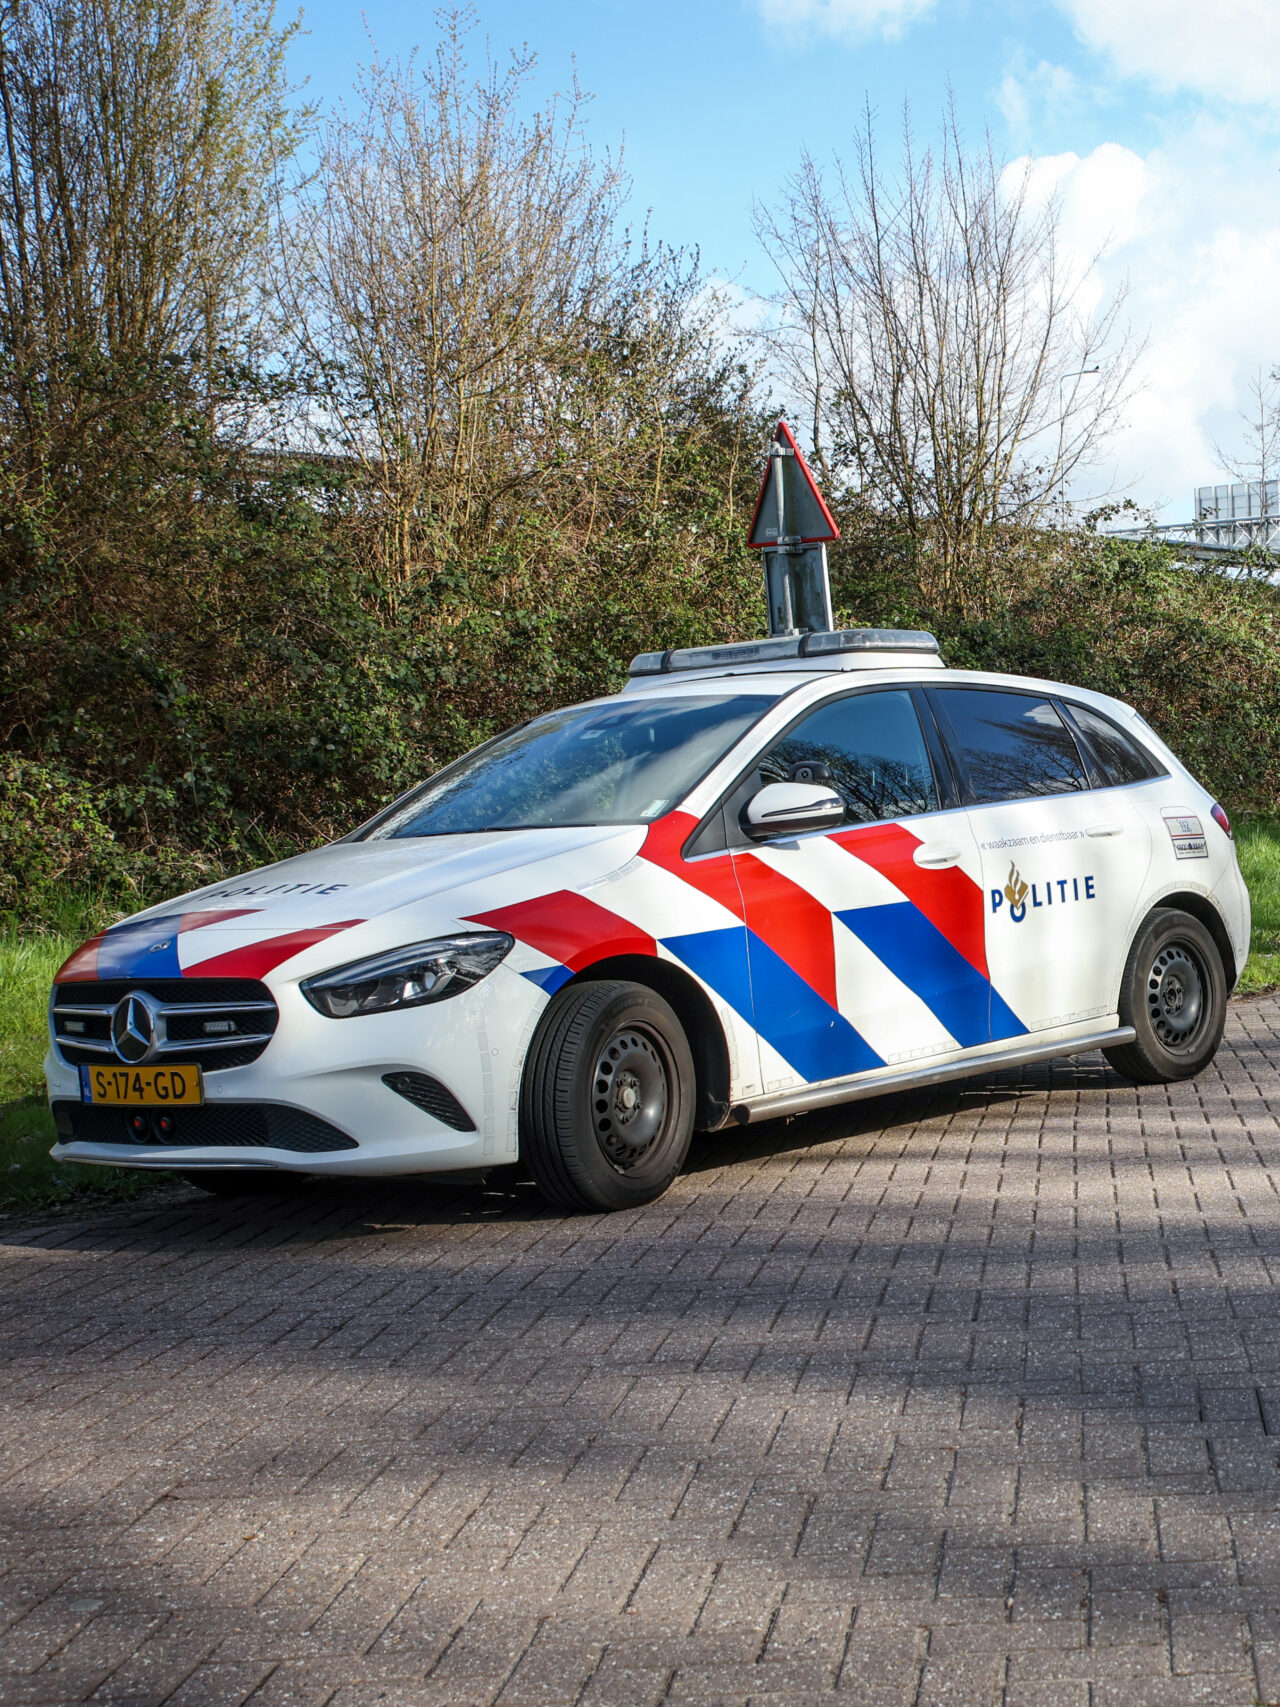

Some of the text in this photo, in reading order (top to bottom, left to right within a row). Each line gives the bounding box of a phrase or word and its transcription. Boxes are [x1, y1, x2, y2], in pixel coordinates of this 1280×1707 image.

[1031, 835, 1041, 845] en
[198, 883, 350, 902] POLITIE
[991, 875, 1096, 923] POLITIE
[95, 1071, 186, 1100] S-174-GD
